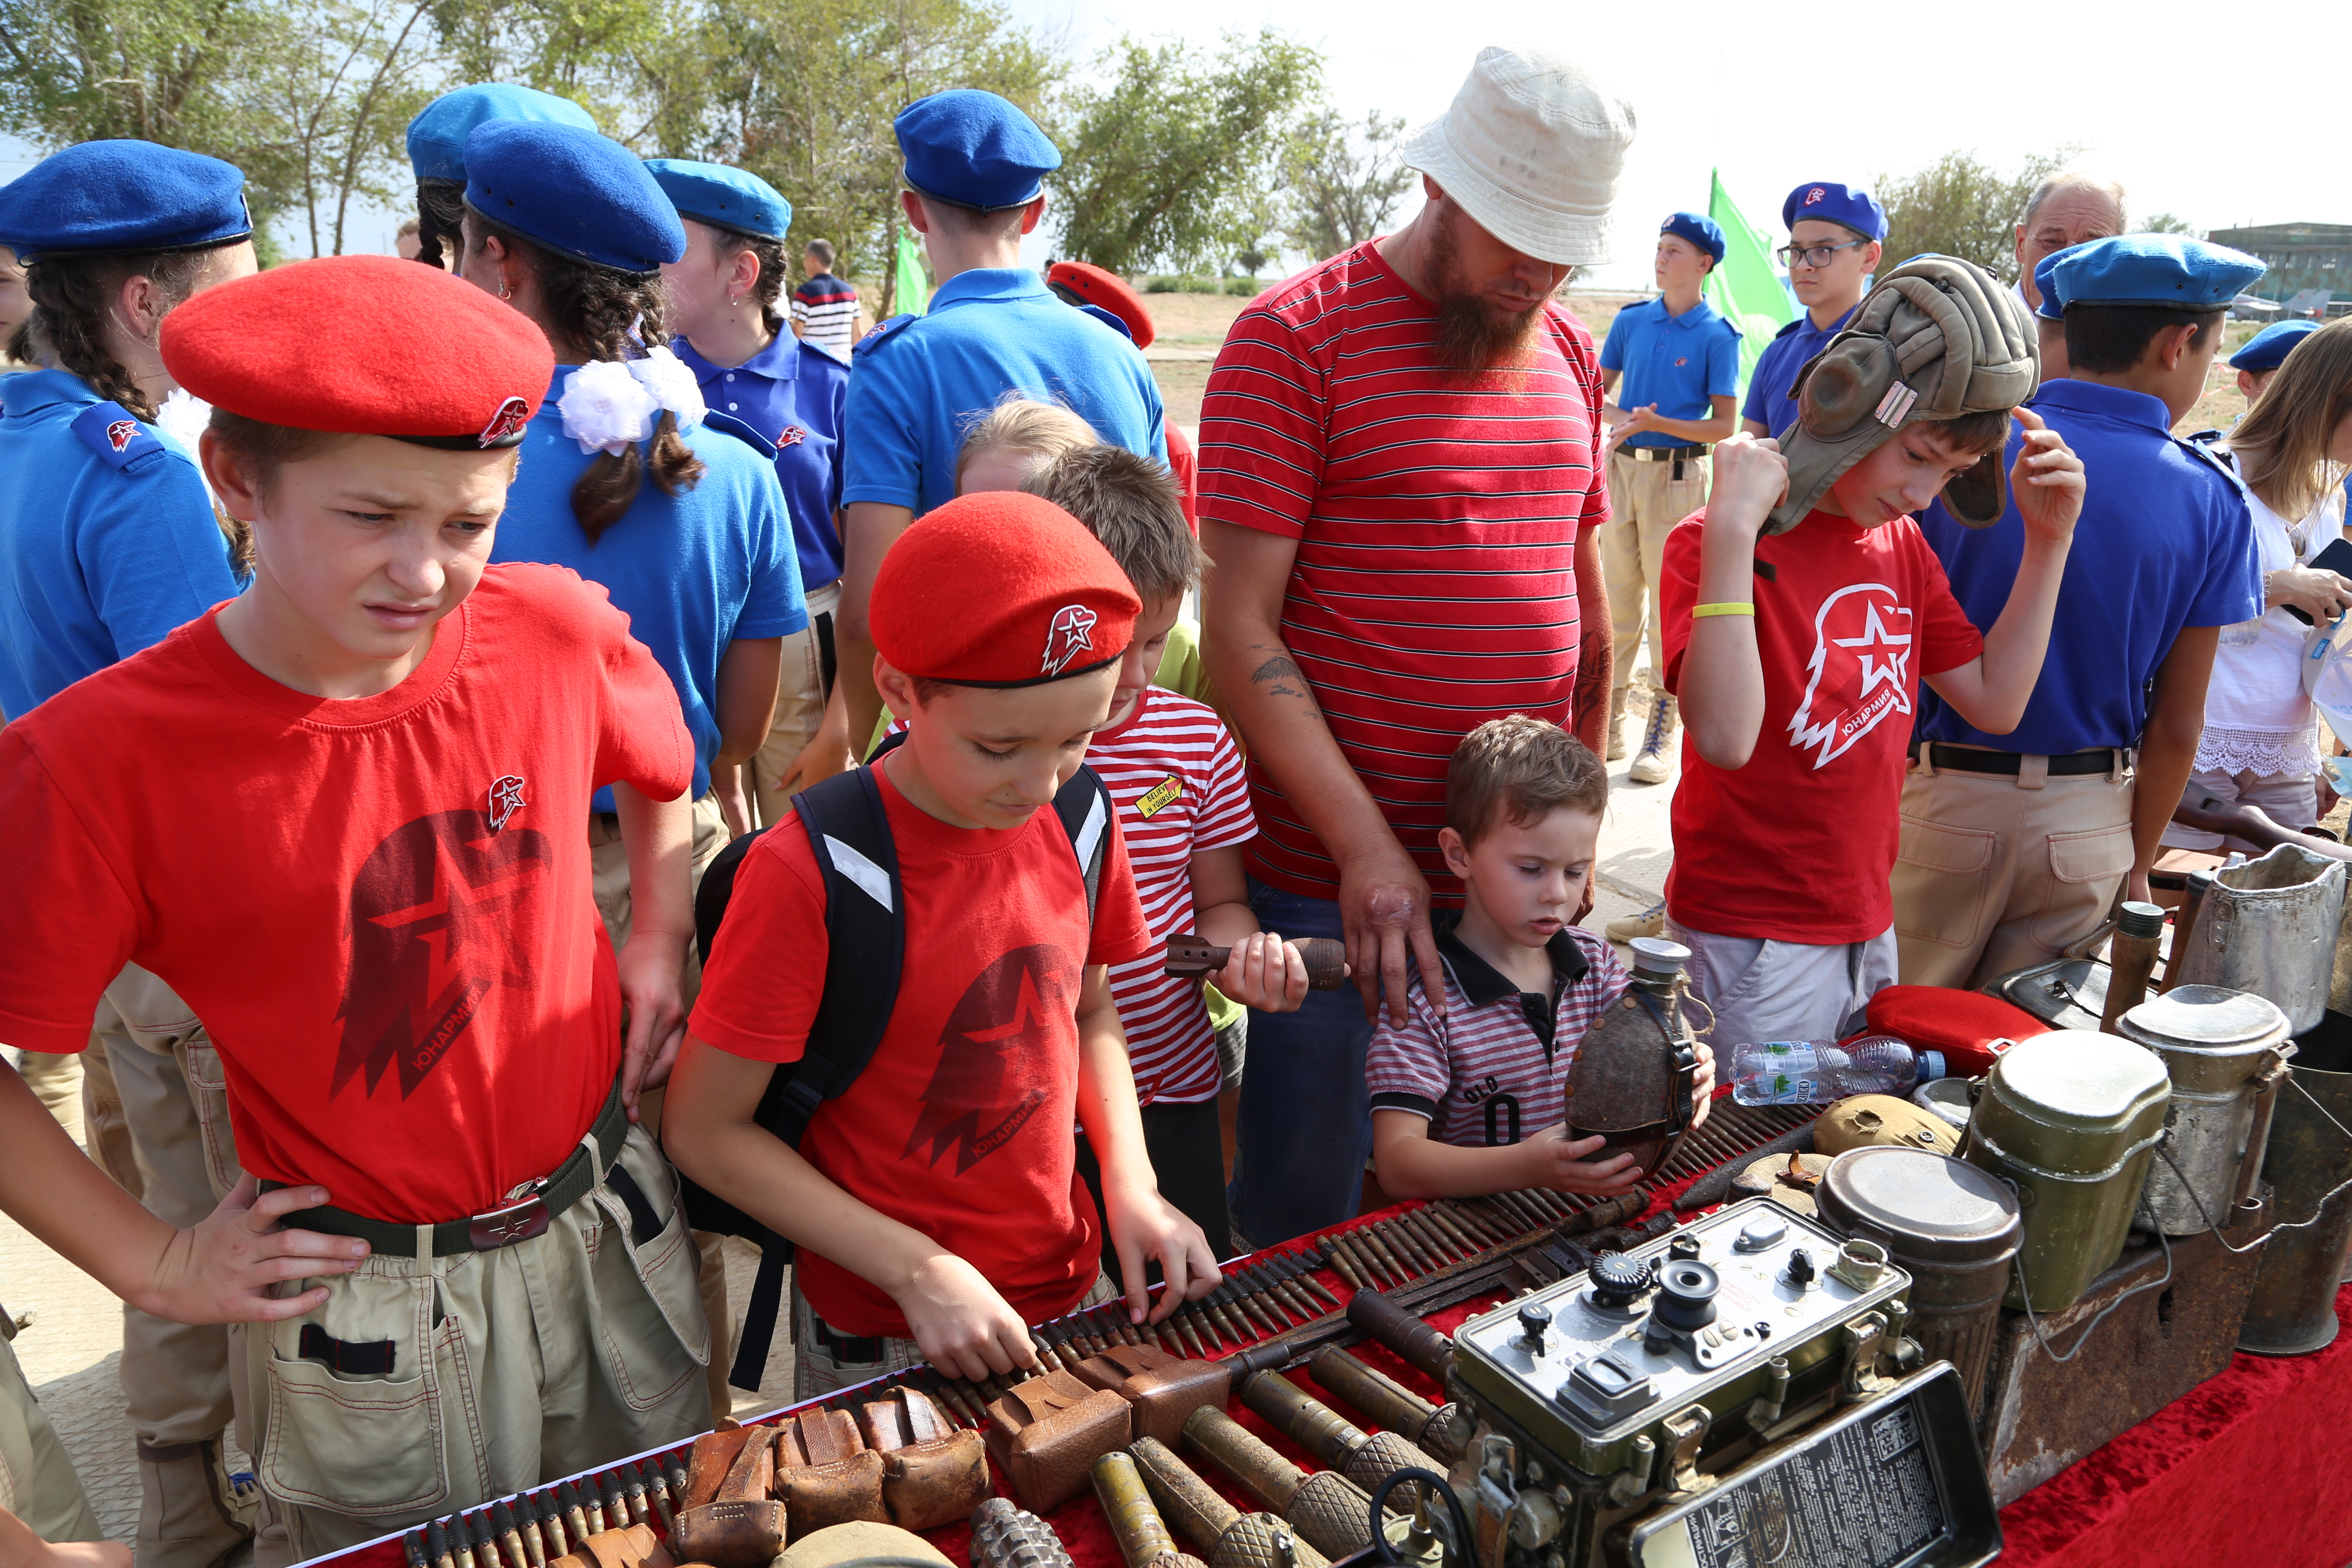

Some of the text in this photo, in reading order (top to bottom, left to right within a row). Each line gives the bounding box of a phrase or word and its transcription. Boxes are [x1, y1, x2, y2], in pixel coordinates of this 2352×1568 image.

[1841, 688, 1891, 737] ЮНАРМИЯ
[1146, 788, 1177, 814] IN YOURSELF
[412, 985, 483, 1072] ЮНАРМИЯ
[1463, 1075, 1498, 1104] OLD
[971, 1094, 1040, 1158] ЮНАРМИЯ
